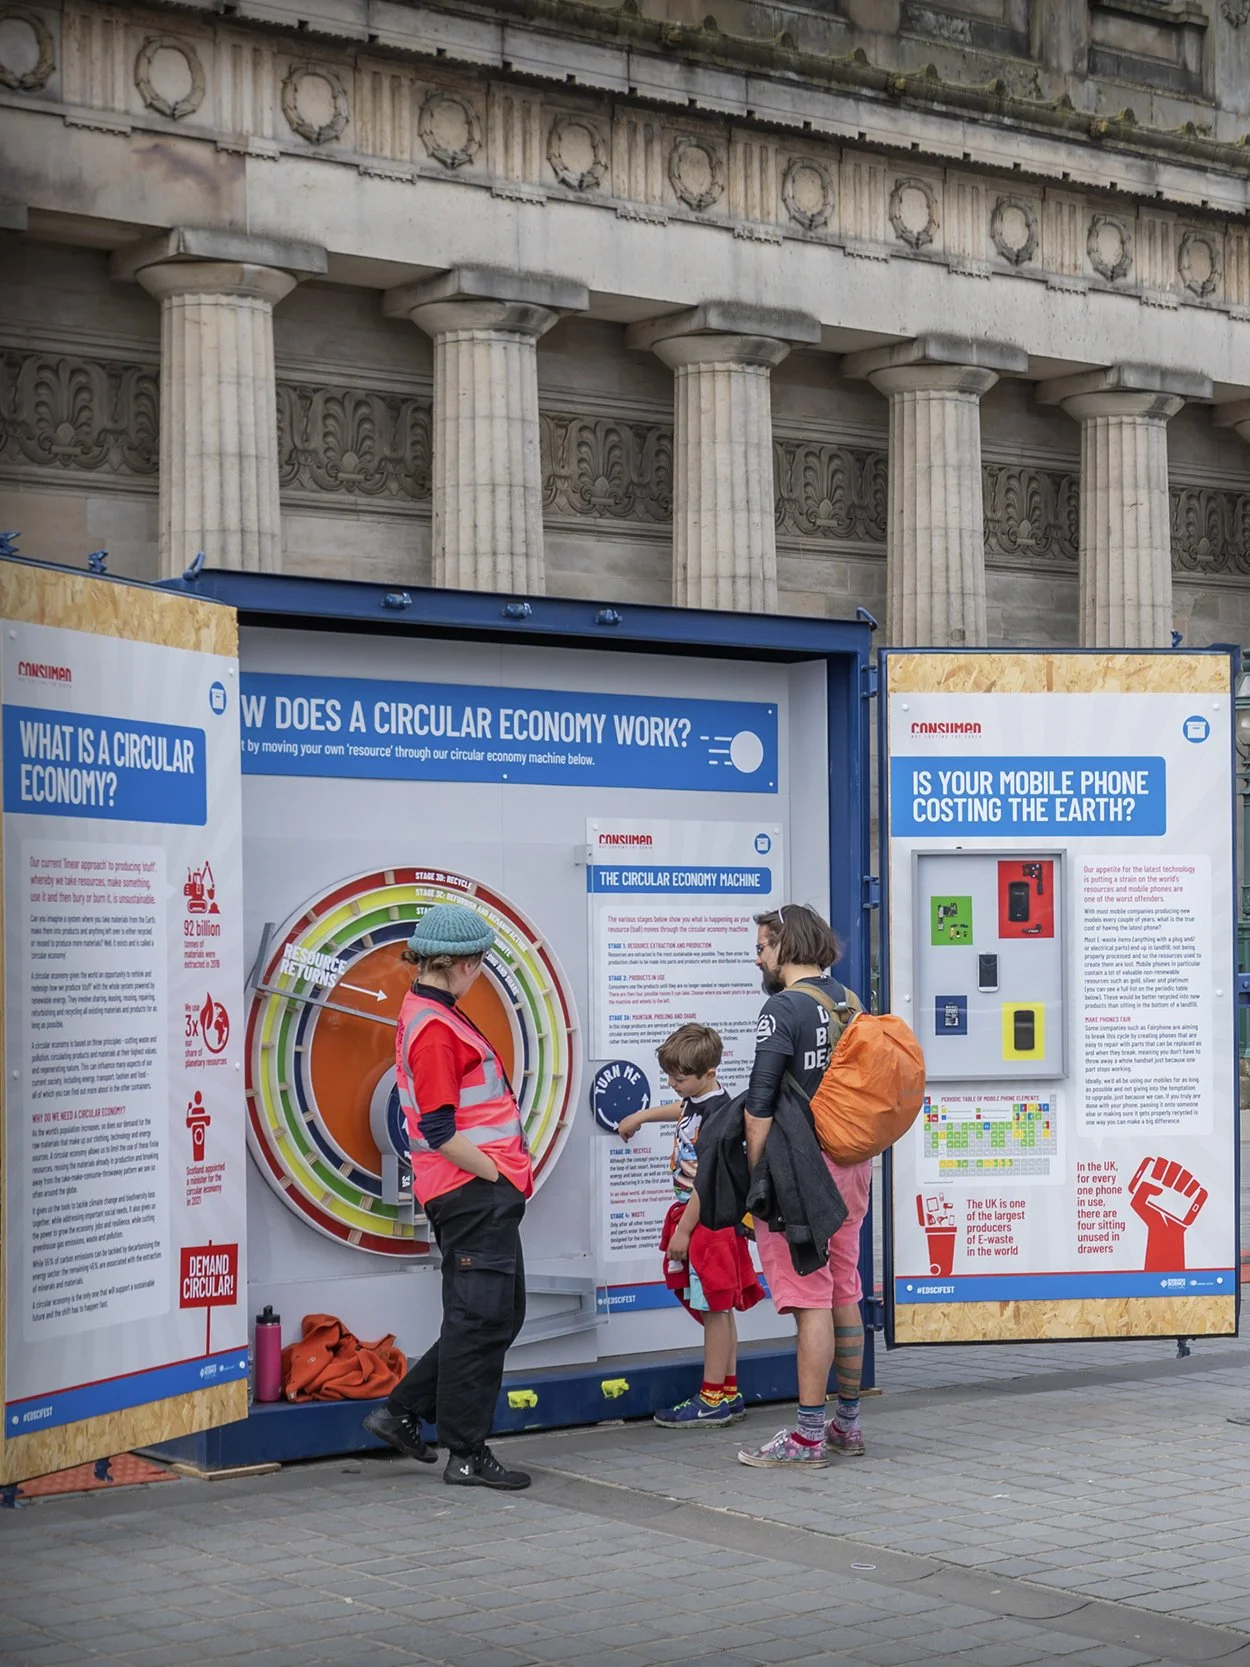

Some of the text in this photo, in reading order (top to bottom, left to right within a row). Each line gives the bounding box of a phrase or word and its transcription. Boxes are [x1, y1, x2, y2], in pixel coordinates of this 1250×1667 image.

[275, 696, 341, 731] DOES
[348, 700, 366, 733] A
[373, 701, 492, 739] CIRCULAR
[499, 708, 606, 744] ECONOMY
[613, 714, 691, 748] WORK?
[20, 720, 194, 774] WHAT IS A CIRCULAR
[247, 739, 259, 754] by
[262, 740, 298, 756] moving
[300, 743, 322, 756] your
[324, 744, 344, 755] own
[346, 743, 393, 757] 'resource'
[394, 745, 431, 761] through
[432, 749, 448, 759] our
[450, 747, 484, 761] circular
[486, 751, 526, 765] economy
[528, 751, 566, 764] machine
[567, 752, 595, 765] below.
[21, 763, 117, 807] ECONOMY?
[913, 770, 1149, 795] IS YOUR MOBILE PHONE
[912, 797, 1135, 822] COSTING THE EARTH?
[1083, 865, 1094, 873] Our
[1095, 865, 1121, 874] appetite
[1122, 865, 1131, 873] for
[1143, 864, 1161, 872] latest
[1162, 865, 1195, 874] technology
[415, 871, 473, 890] STAGE 3D: RECYCLE
[599, 871, 760, 886] THE CIRCULAR ECONOMY MACHINE
[1083, 875, 1089, 883] is
[1090, 875, 1112, 884] putting
[1118, 875, 1137, 883] strain
[415, 888, 435, 898] STAGE
[1128, 884, 1148, 892] mobile
[1149, 885, 1172, 893] phones
[1134, 894, 1165, 902] offenders.
[636, 916, 653, 924] stages
[681, 916, 690, 924] you
[708, 915, 733, 924] happening
[739, 916, 750, 924] your
[183, 919, 220, 936] 92 billion
[629, 925, 643, 933] (ball)
[659, 925, 678, 934] through
[706, 926, 728, 934] economy
[283, 942, 348, 976] RESOURCE
[279, 958, 338, 988] RETURNS
[184, 1014, 200, 1037] 3x
[595, 1064, 641, 1095] TURN ME
[1076, 1160, 1118, 1172] In the UK,
[1076, 1173, 1116, 1186] for every
[1076, 1183, 1122, 1197] one phone
[966, 1198, 1025, 1209] The UK is one
[1076, 1198, 1105, 1207] in use,
[966, 1210, 1024, 1222] of the largest
[1077, 1208, 1117, 1220] there are
[966, 1222, 1011, 1236] producers
[1077, 1219, 1125, 1232] four sitting
[966, 1233, 1013, 1246] of E-waste
[1077, 1231, 1119, 1242] unused in
[966, 1245, 1018, 1256] in the world
[1077, 1243, 1113, 1253] drawers
[189, 1254, 232, 1279] DEMAND
[182, 1273, 233, 1299] CIRCULAR!
[916, 1285, 955, 1294] #EDSCIFEST
[22, 1405, 52, 1422] #EDSCIFEST
